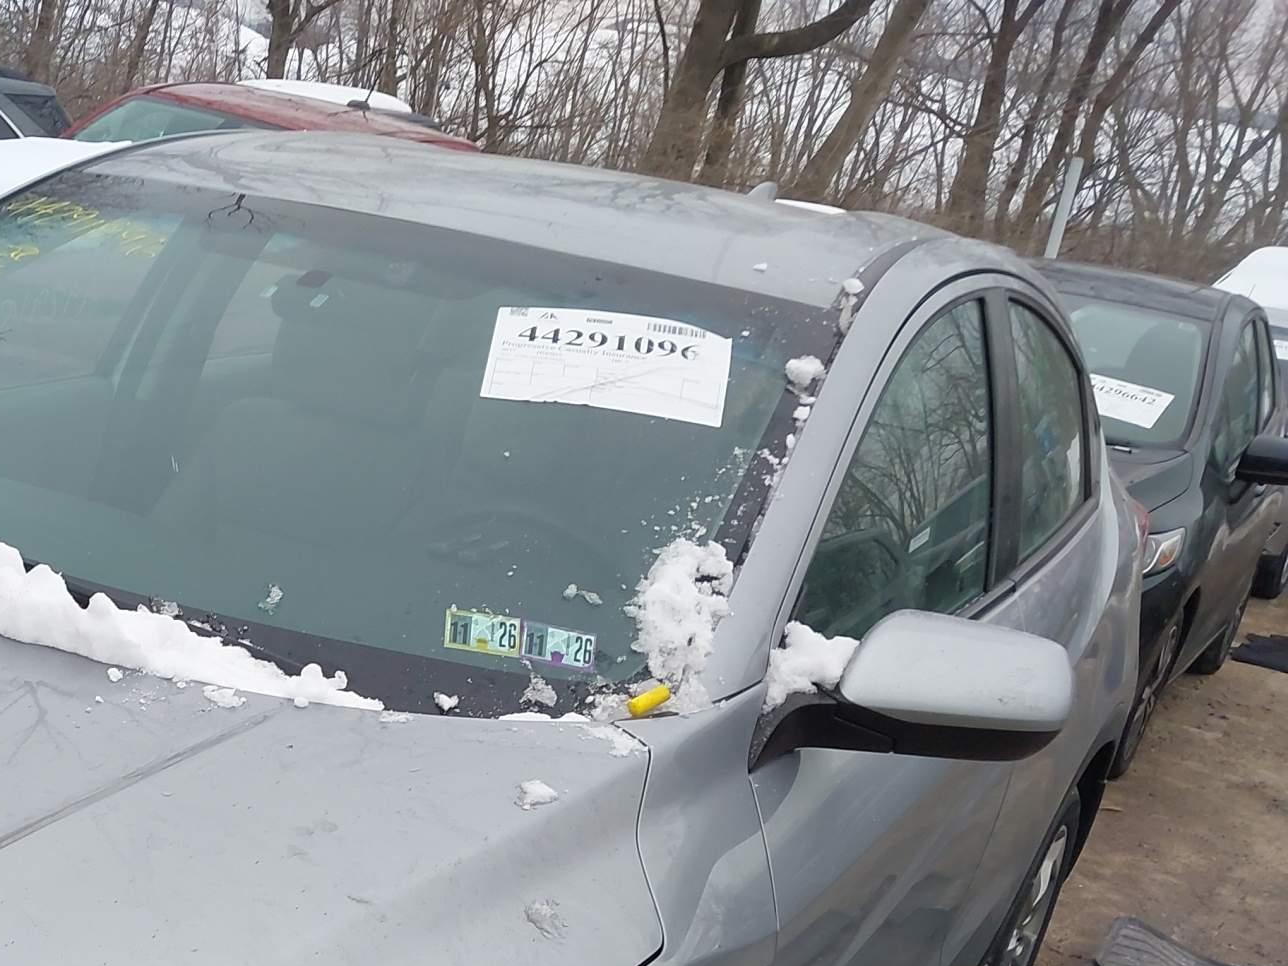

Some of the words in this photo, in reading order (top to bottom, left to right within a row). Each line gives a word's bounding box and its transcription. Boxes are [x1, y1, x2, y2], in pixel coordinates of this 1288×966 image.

[518, 325, 700, 361] 44291096
[498, 621, 517, 649] 26
[573, 635, 593, 664] 26
